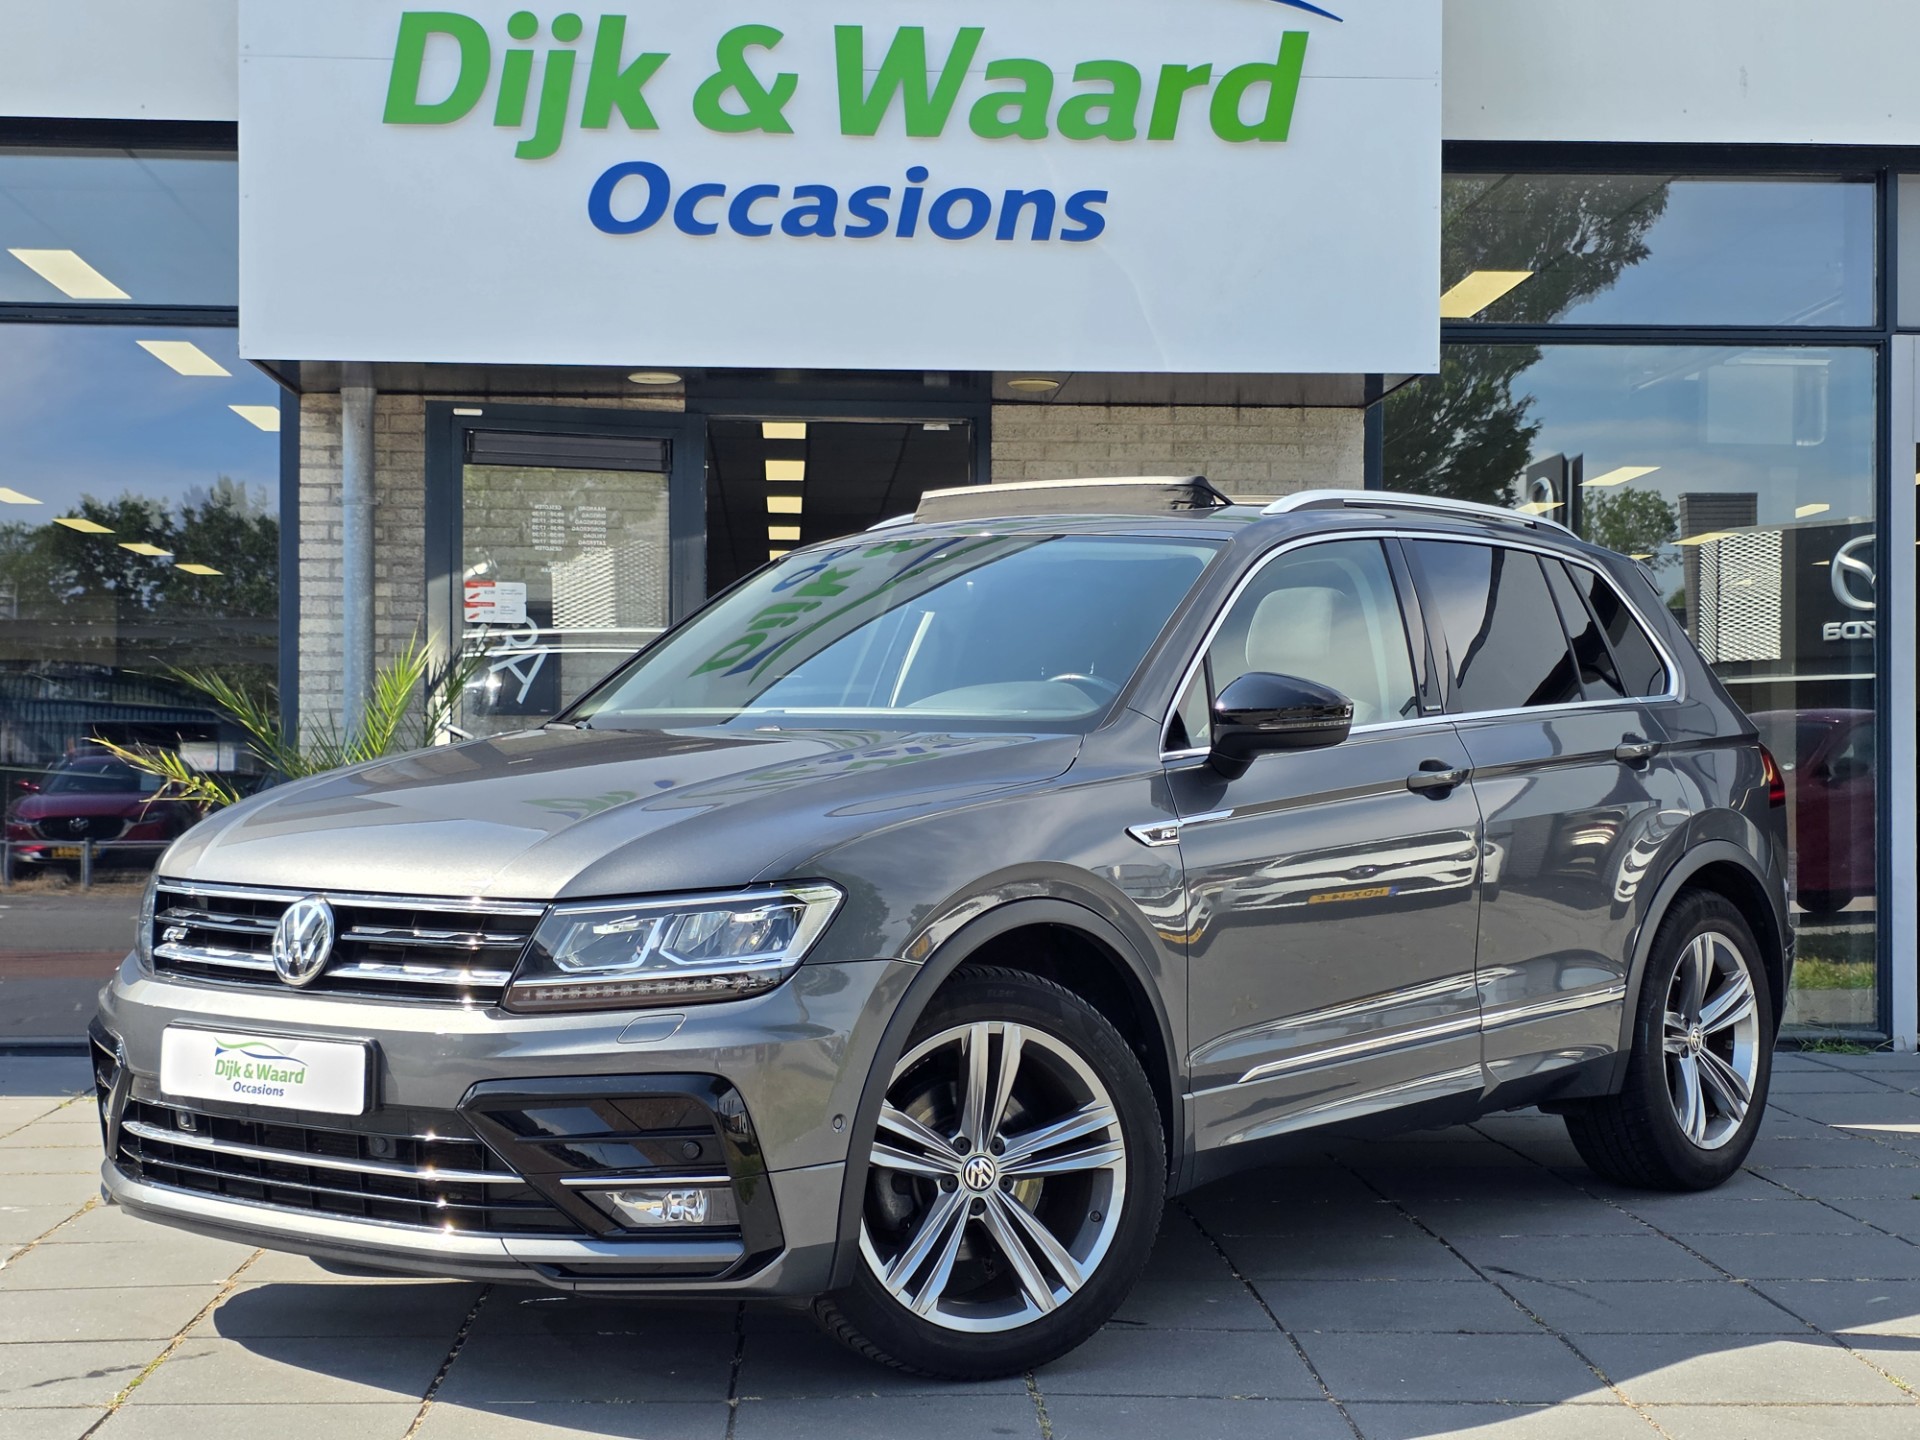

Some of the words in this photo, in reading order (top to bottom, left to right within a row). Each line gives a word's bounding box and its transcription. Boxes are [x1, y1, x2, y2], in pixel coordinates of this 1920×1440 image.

[382, 11, 671, 160] Dijk
[692, 24, 798, 134] &
[834, 25, 1309, 143] Waard
[588, 161, 1108, 242] Occasions
[215, 1060, 241, 1080] Dijk
[243, 1063, 254, 1079] &
[256, 1063, 305, 1084] Waard
[233, 1081, 284, 1097] Occasions
